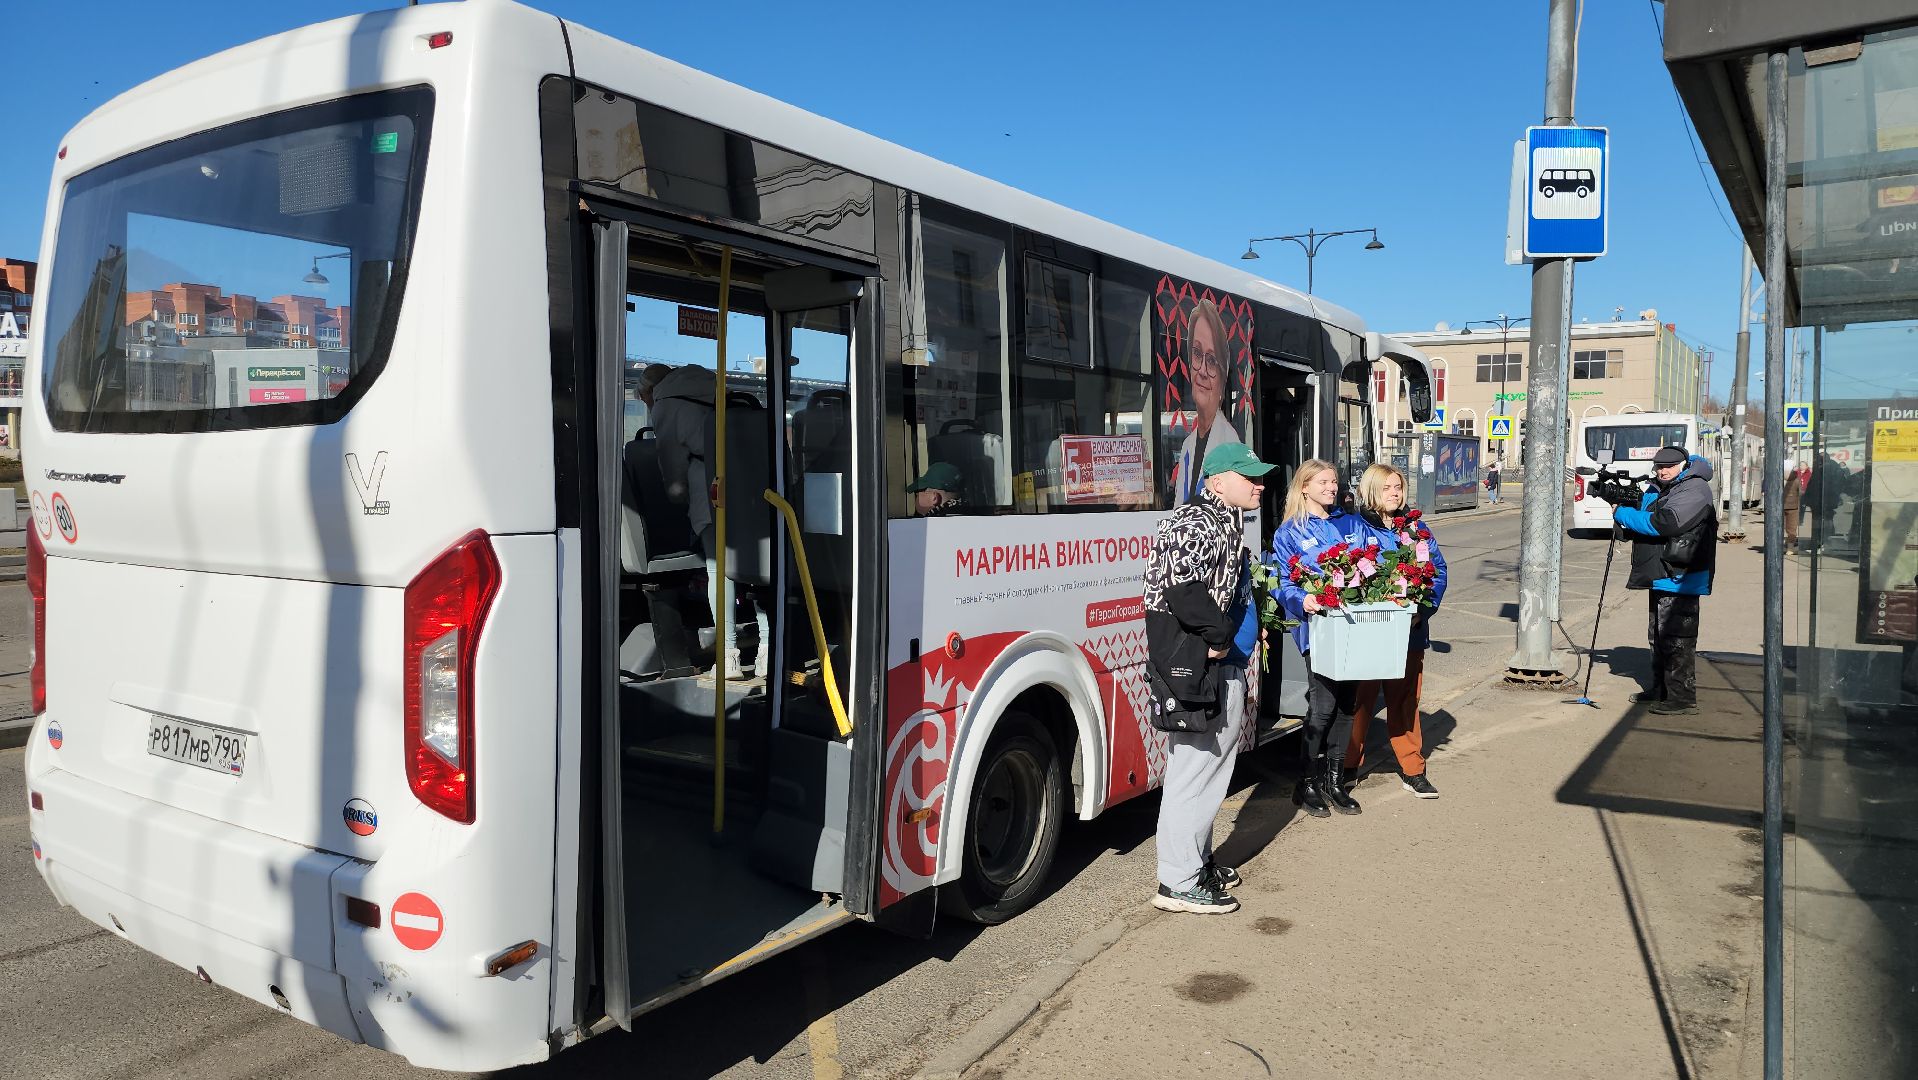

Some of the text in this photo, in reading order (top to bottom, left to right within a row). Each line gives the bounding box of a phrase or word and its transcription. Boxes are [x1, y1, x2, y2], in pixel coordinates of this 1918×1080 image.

[680, 317, 719, 337] ВЫХОД
[1067, 448, 1081, 490] 5
[57, 505, 73, 531] 80
[956, 542, 1051, 577] МАРИНА
[152, 724, 240, 763] Р817МВ 790
[347, 807, 374, 826] RUS
